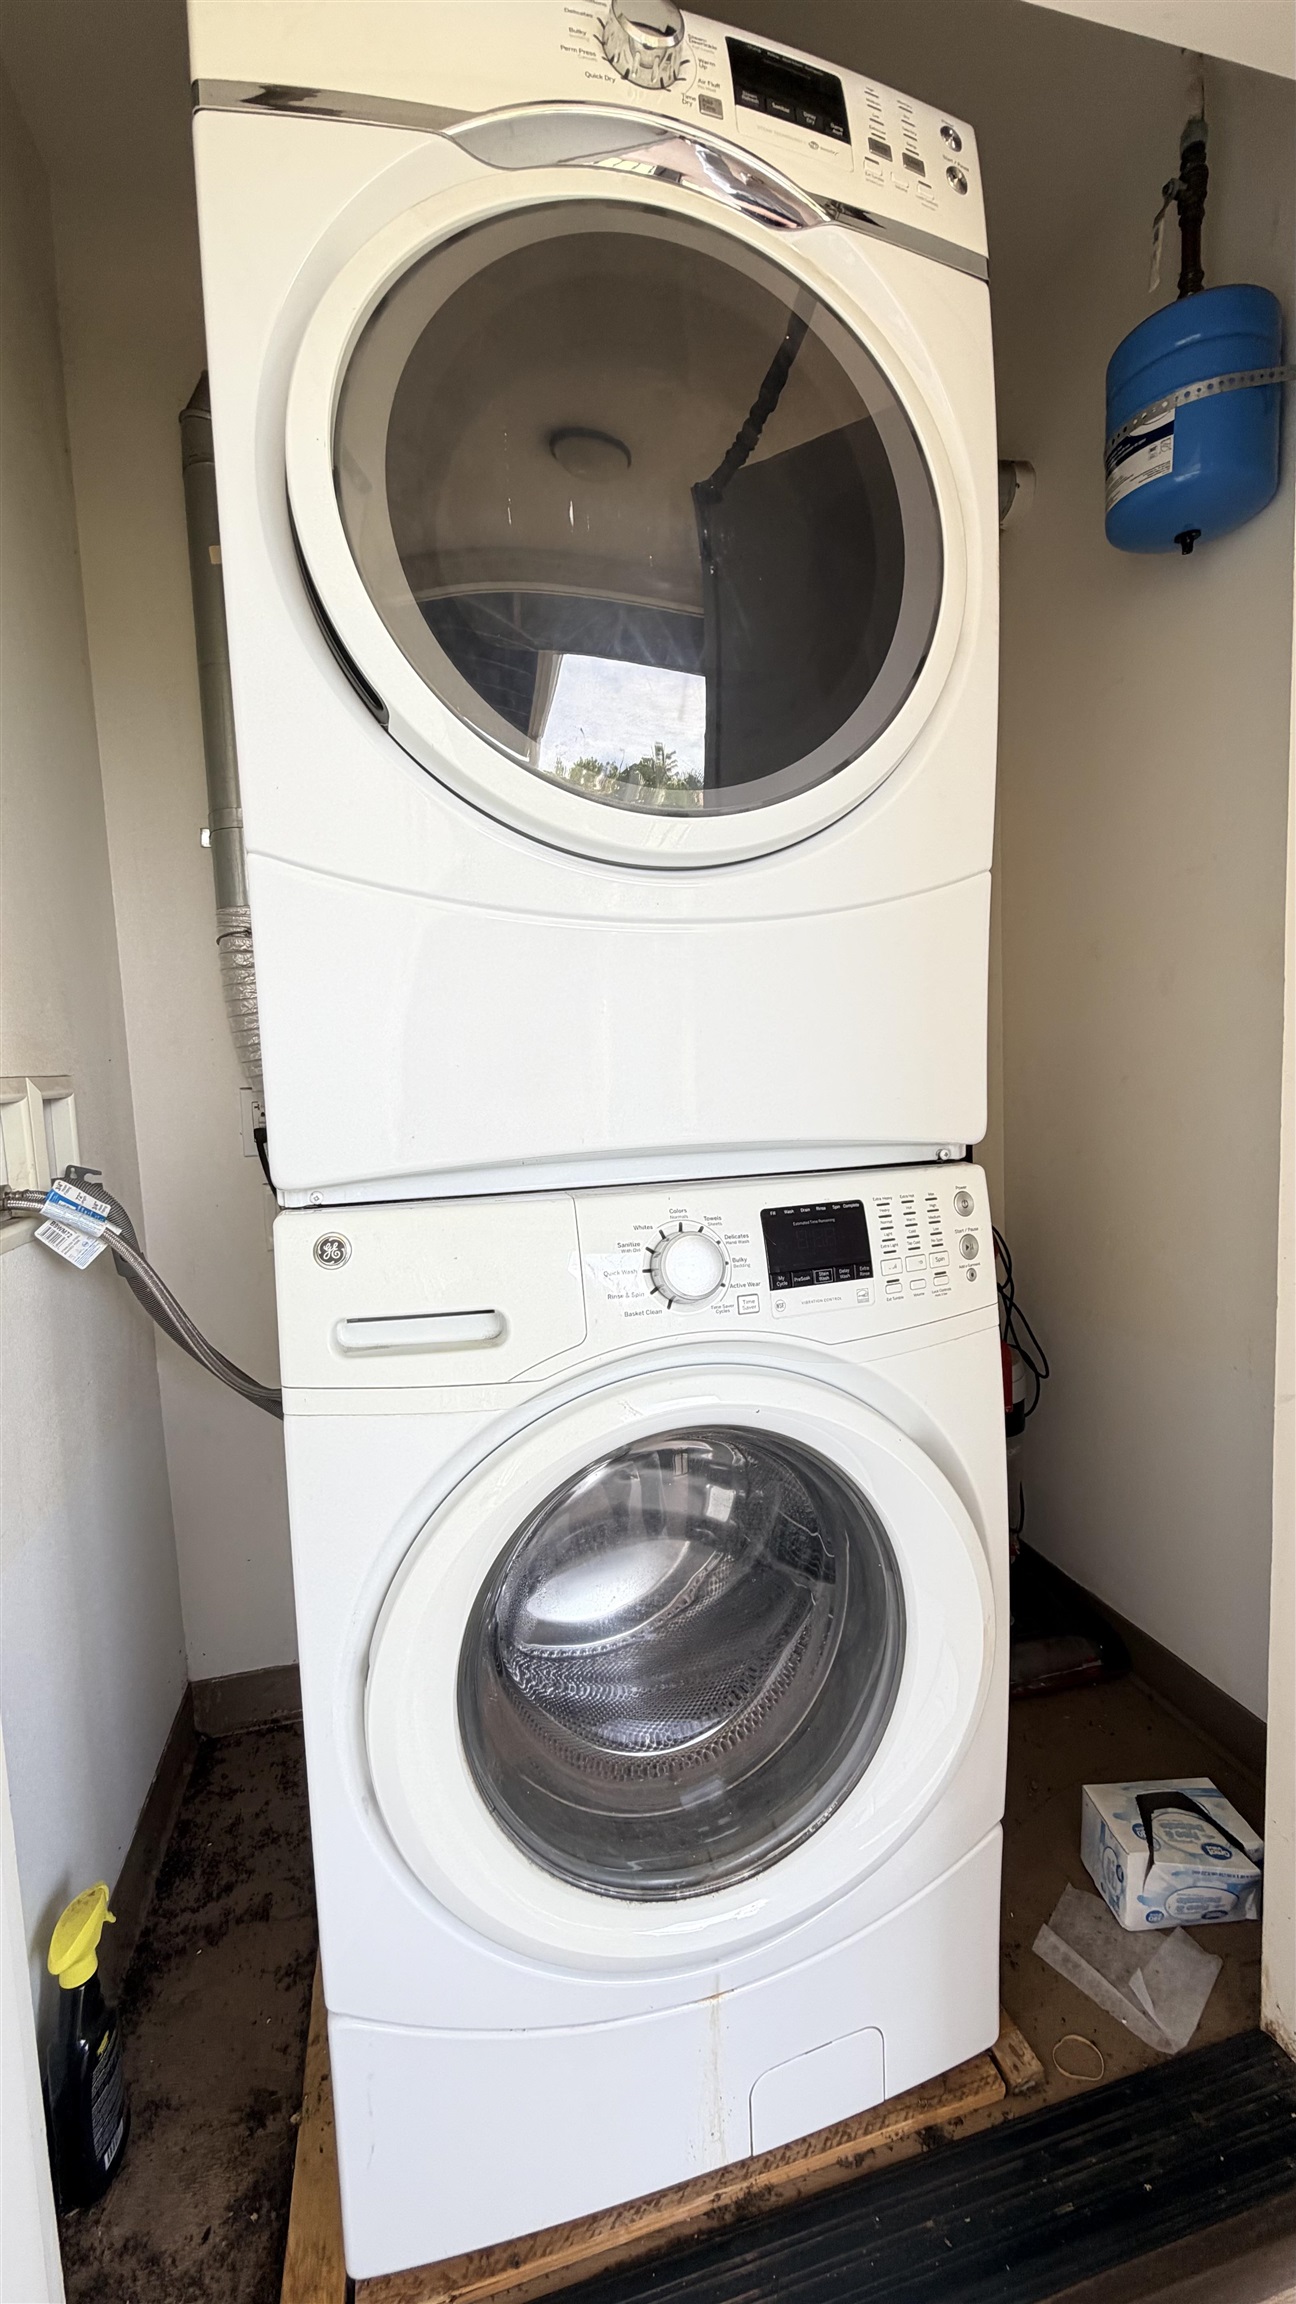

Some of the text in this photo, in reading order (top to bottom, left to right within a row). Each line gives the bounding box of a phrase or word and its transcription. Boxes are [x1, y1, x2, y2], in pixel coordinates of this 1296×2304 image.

[560, 45, 597, 57] Perm Press
[584, 71, 616, 83] Quick Dry
[681, 93, 697, 102] Time
[603, 1270, 620, 1278] Quick
[631, 1292, 645, 1300] Spin
